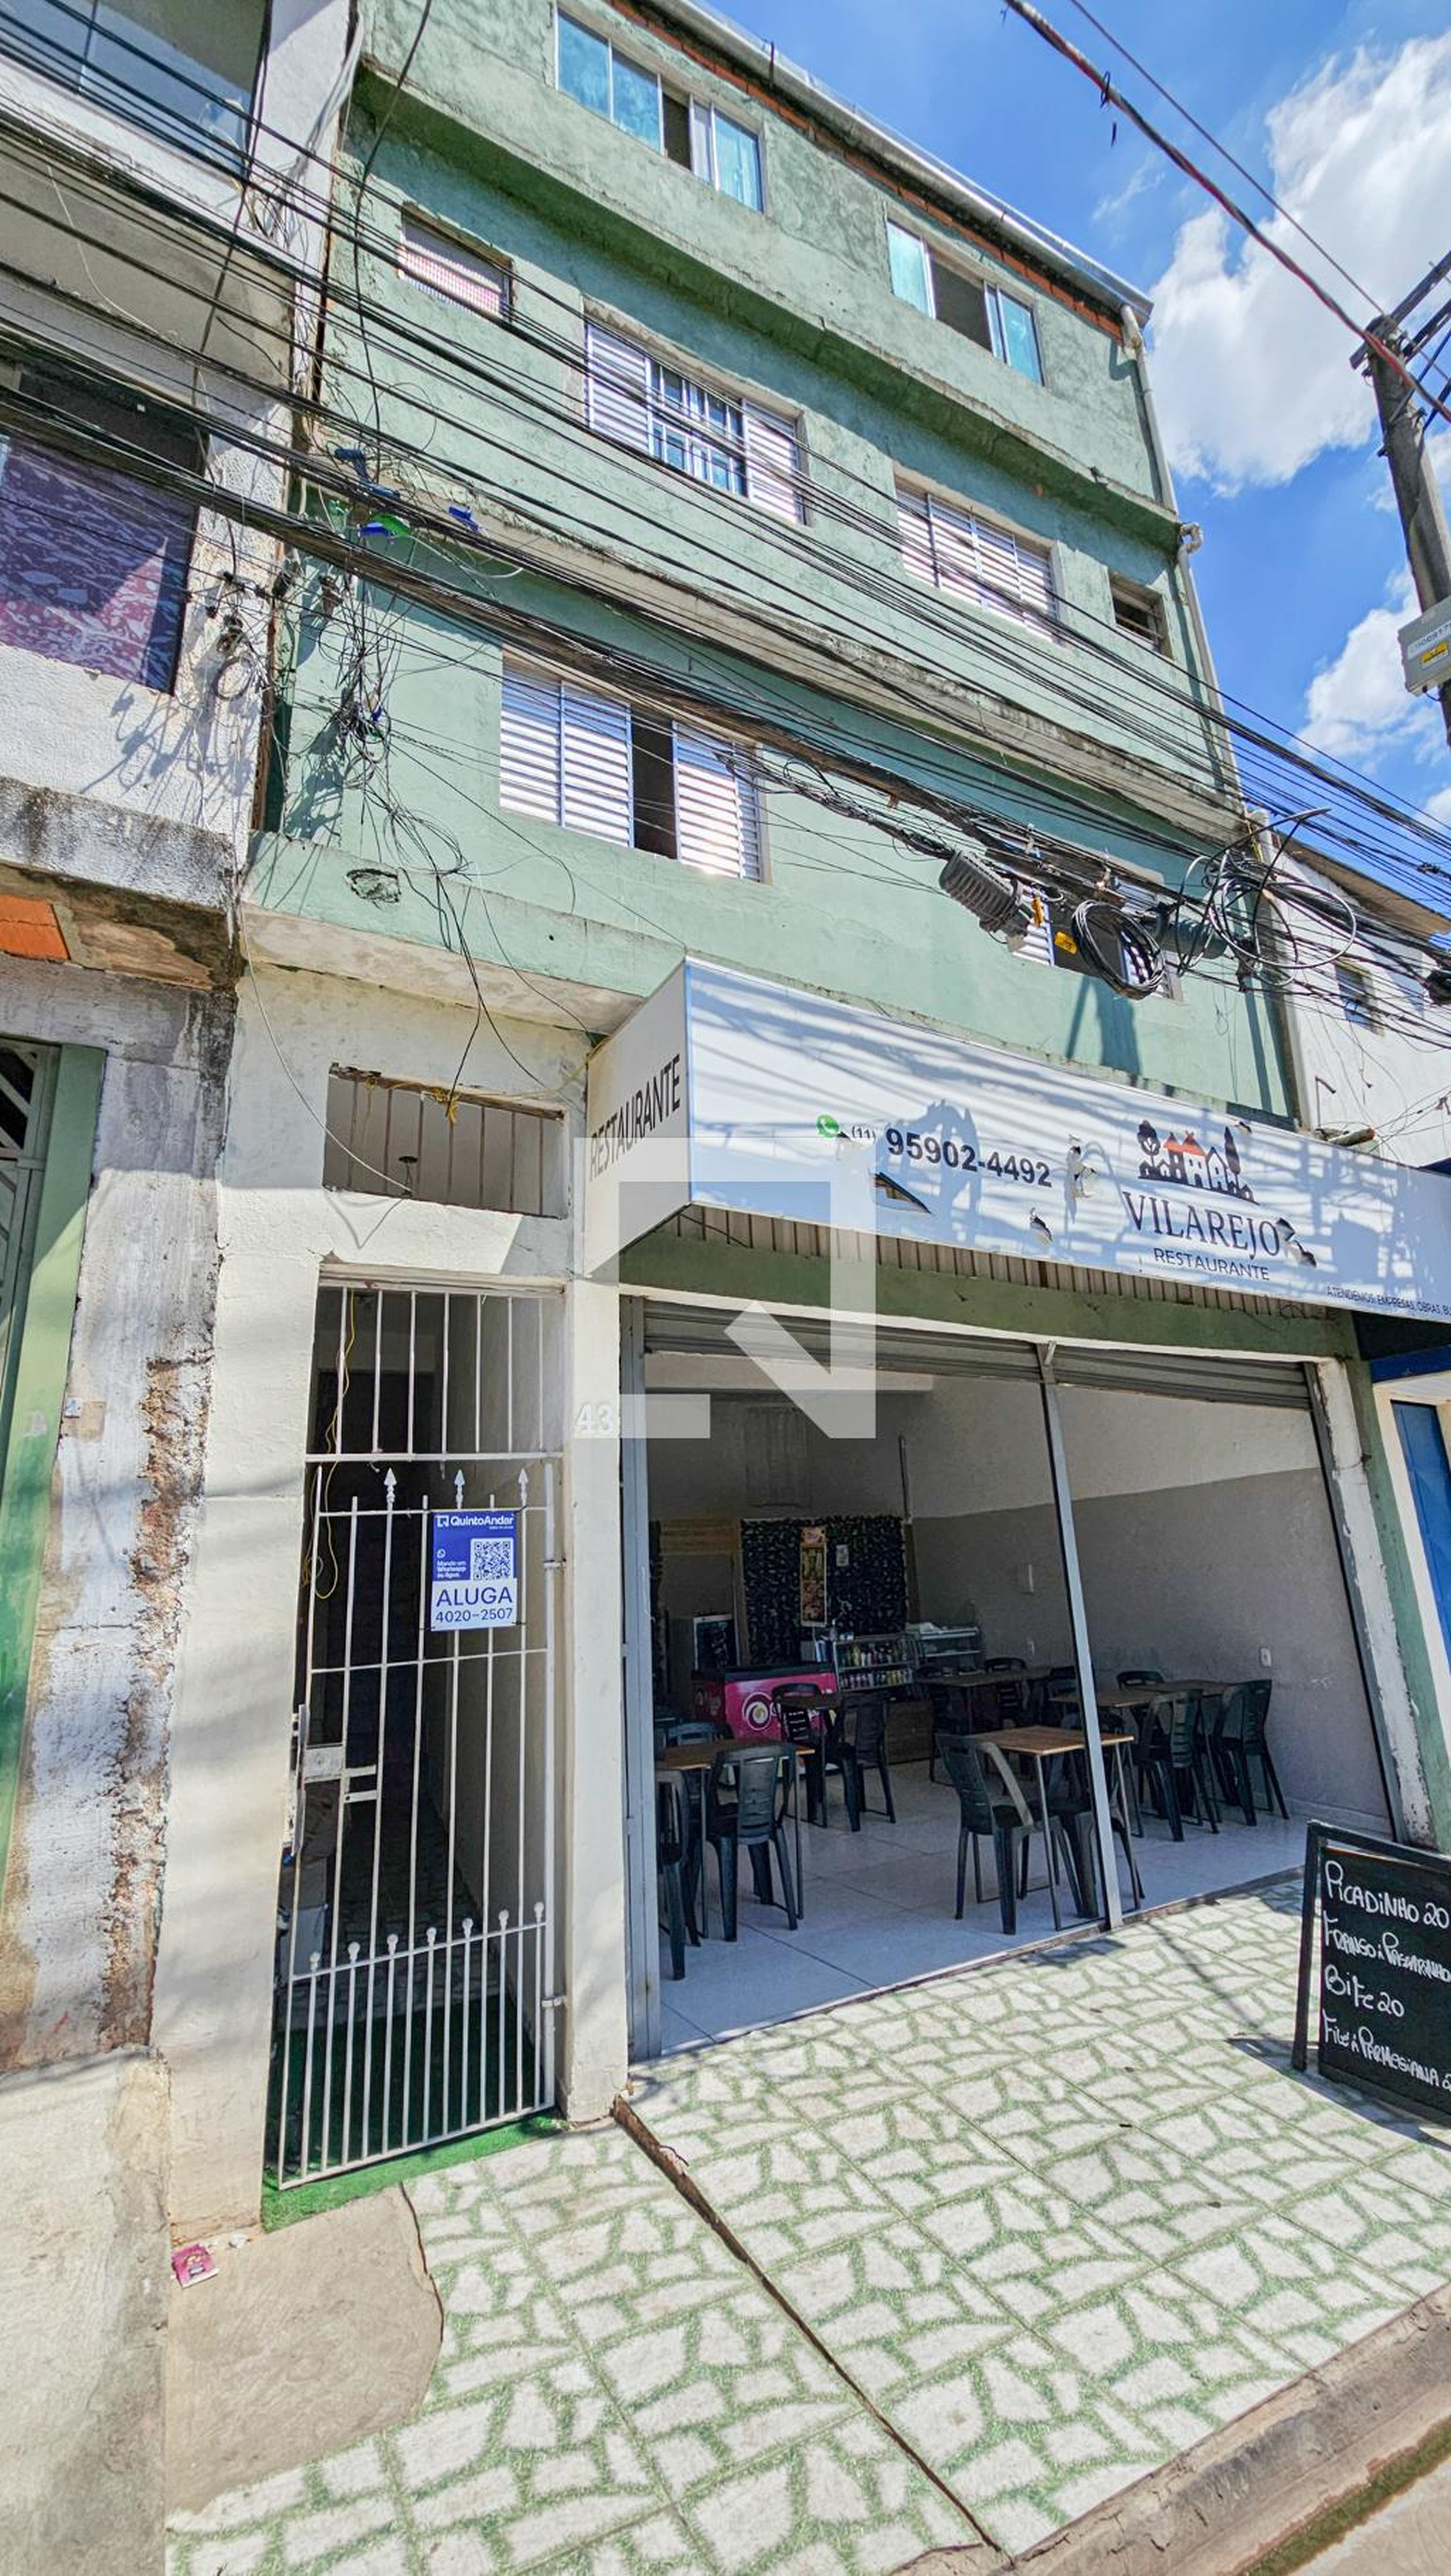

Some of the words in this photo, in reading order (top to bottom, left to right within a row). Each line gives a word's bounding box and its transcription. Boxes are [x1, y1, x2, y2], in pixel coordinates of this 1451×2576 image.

[589, 1053, 680, 1181] RESTAURANTE
[851, 1126, 876, 1143] (11)
[886, 1127, 1052, 1188] 95902-4492
[1122, 1191, 1280, 1260] VILAREJO
[1153, 1248, 1270, 1281] RESTAURANTE
[450, 1515, 514, 1526] QuintoAndar
[436, 1586, 513, 1607] ALUGA
[436, 1608, 513, 1623] 4020-2507
[1423, 1902, 1449, 1928] 20
[1377, 1992, 1405, 2017] 20
